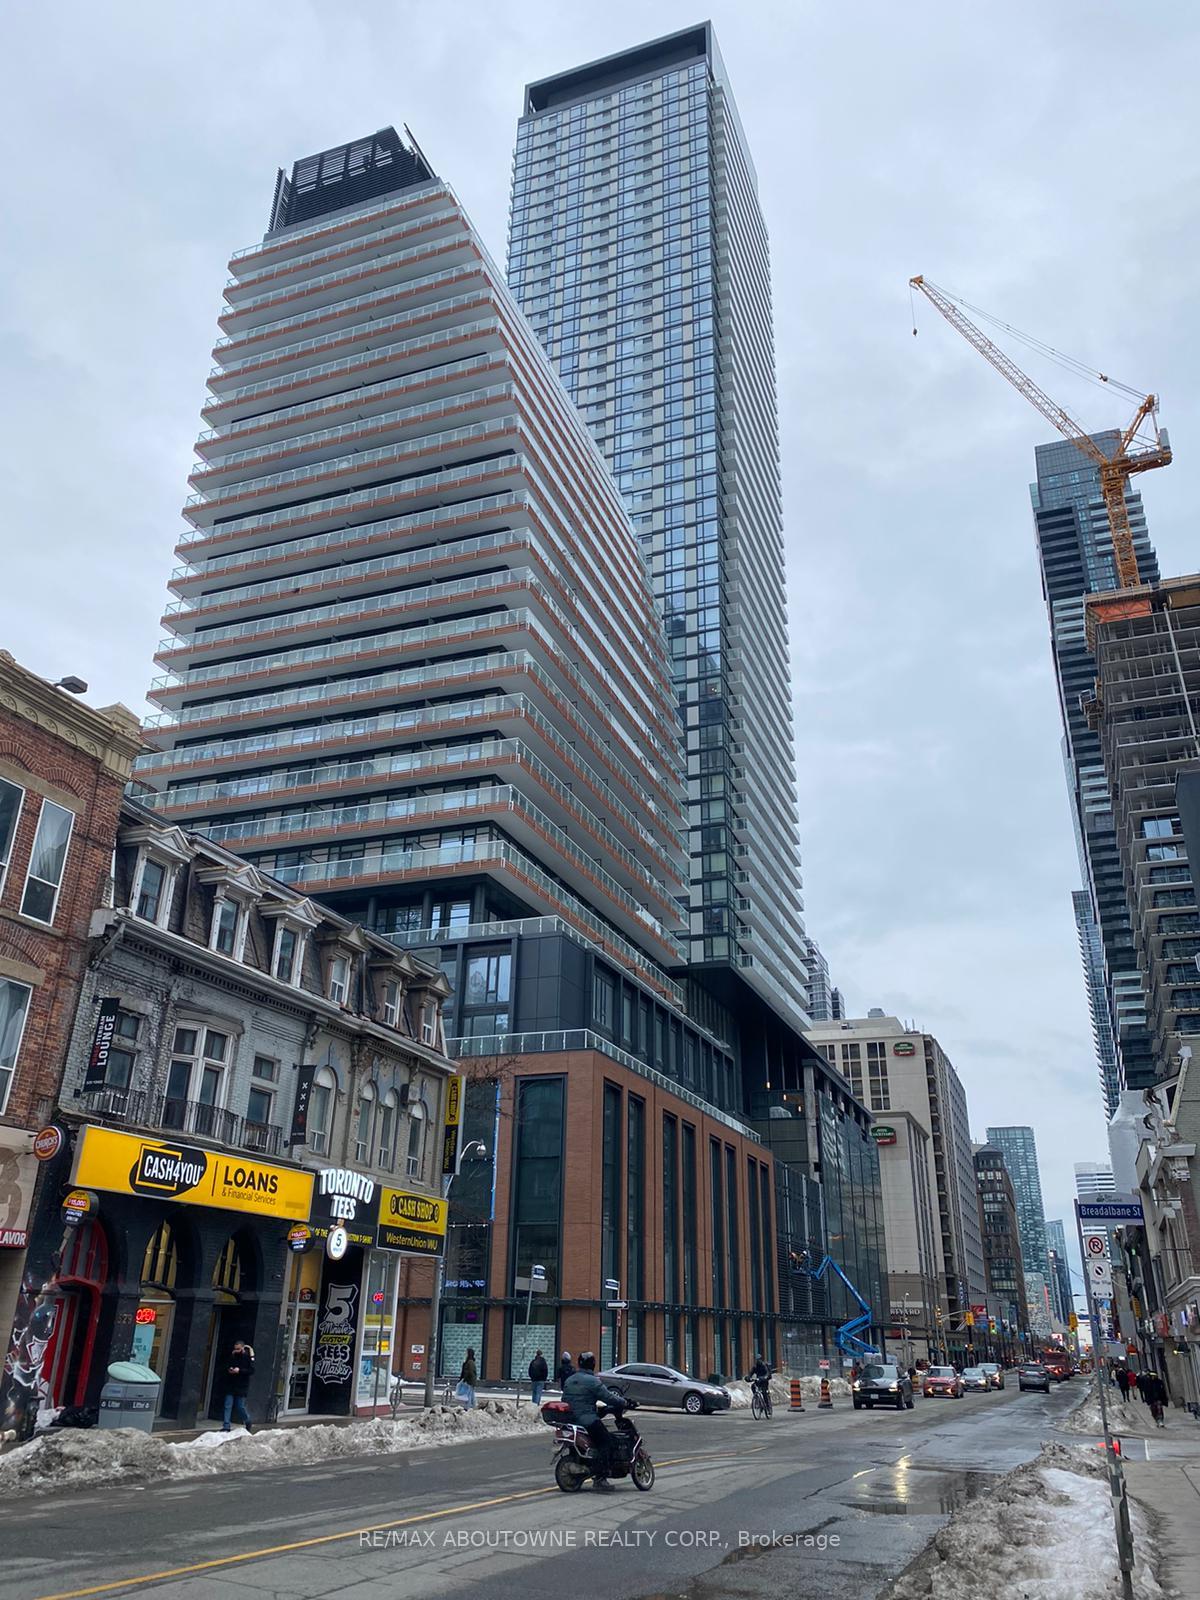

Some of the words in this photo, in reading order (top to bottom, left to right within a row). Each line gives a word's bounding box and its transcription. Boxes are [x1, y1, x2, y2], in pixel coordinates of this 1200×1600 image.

[97, 1015, 116, 1066] LOUNGE
[224, 1165, 279, 1194] LOANS
[319, 1168, 375, 1204] TORONTO
[228, 1188, 253, 1202] Financial
[254, 1192, 277, 1205] Services
[330, 1195, 357, 1220] TEES
[399, 1197, 416, 1217] CASH
[416, 1201, 434, 1220] SHOP
[1081, 1205, 1132, 1216] Breadalbane
[1133, 1206, 1141, 1216] St
[336, 1234, 343, 1247] 5
[136, 1308, 156, 1321] OPEN
[326, 1285, 354, 1323] 5
[318, 1345, 349, 1360] TEES
